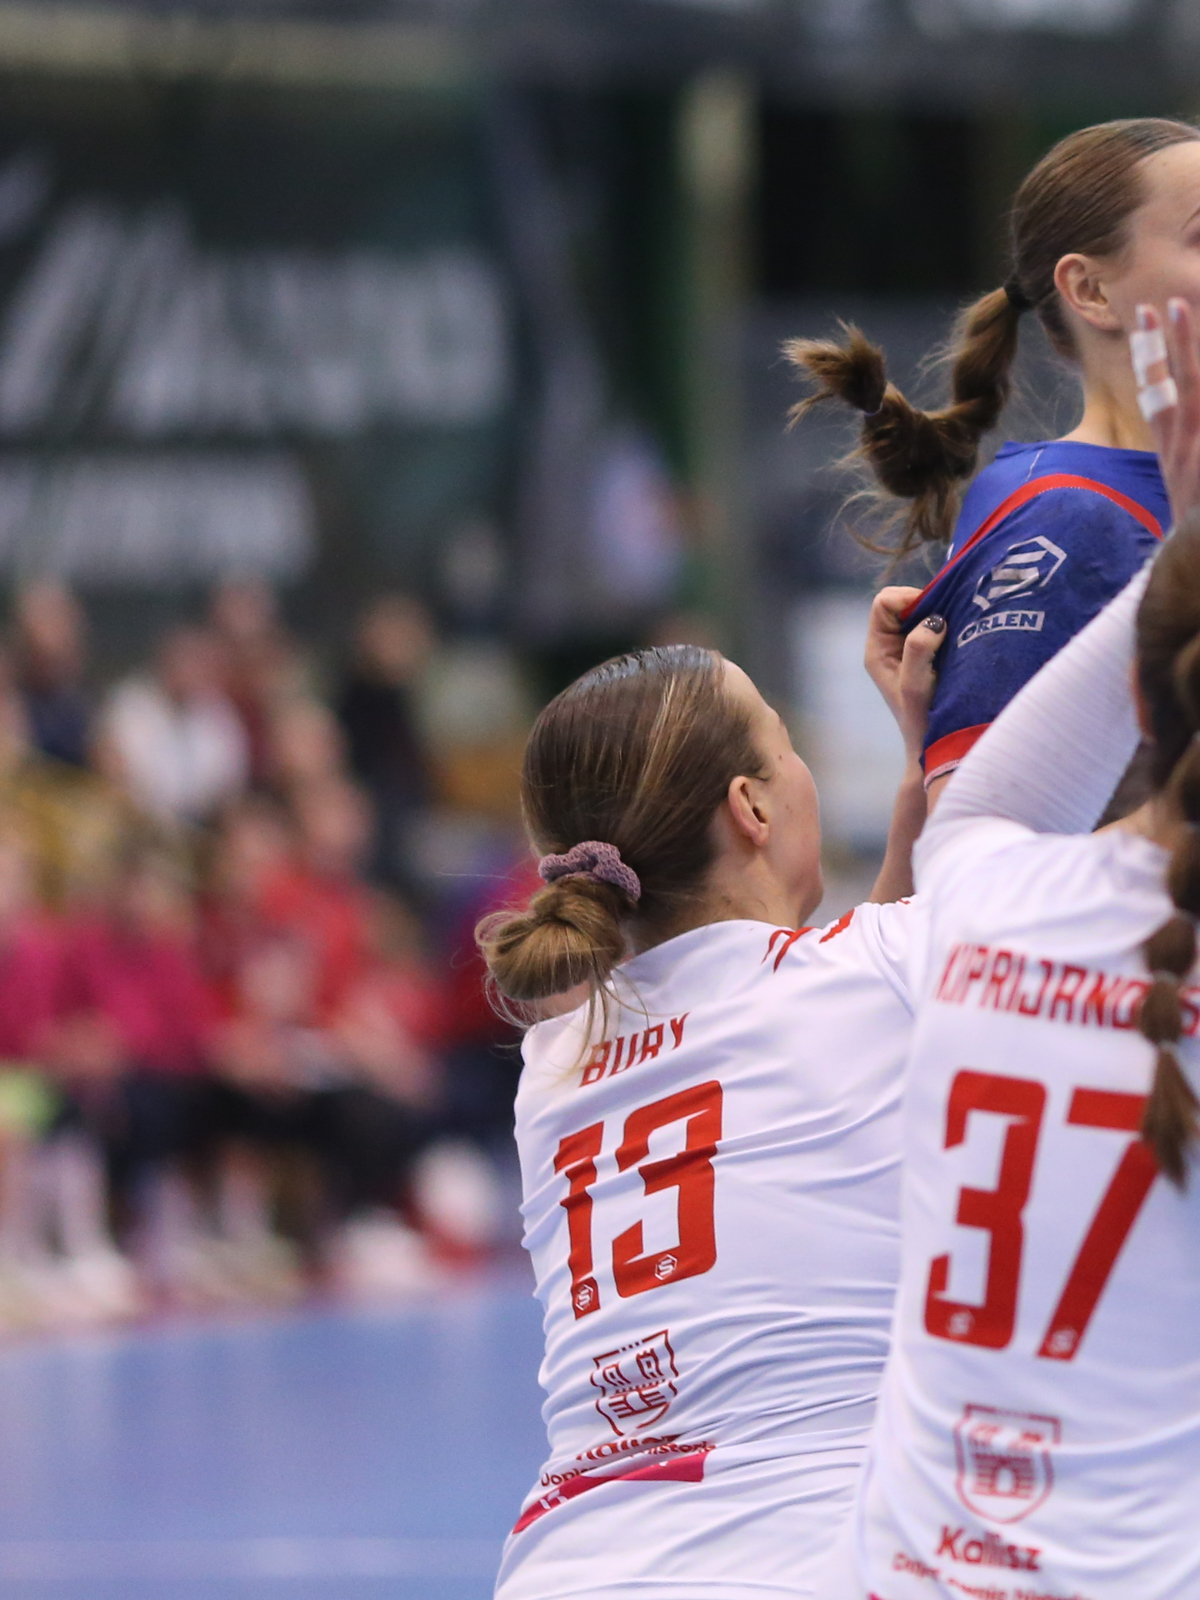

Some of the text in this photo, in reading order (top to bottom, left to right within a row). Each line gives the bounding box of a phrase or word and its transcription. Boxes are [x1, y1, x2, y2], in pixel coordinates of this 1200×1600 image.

[960, 612, 1039, 642] ORLEN
[579, 1011, 690, 1088] BURY
[553, 1079, 723, 1321] 13
[924, 1068, 1162, 1362] 37
